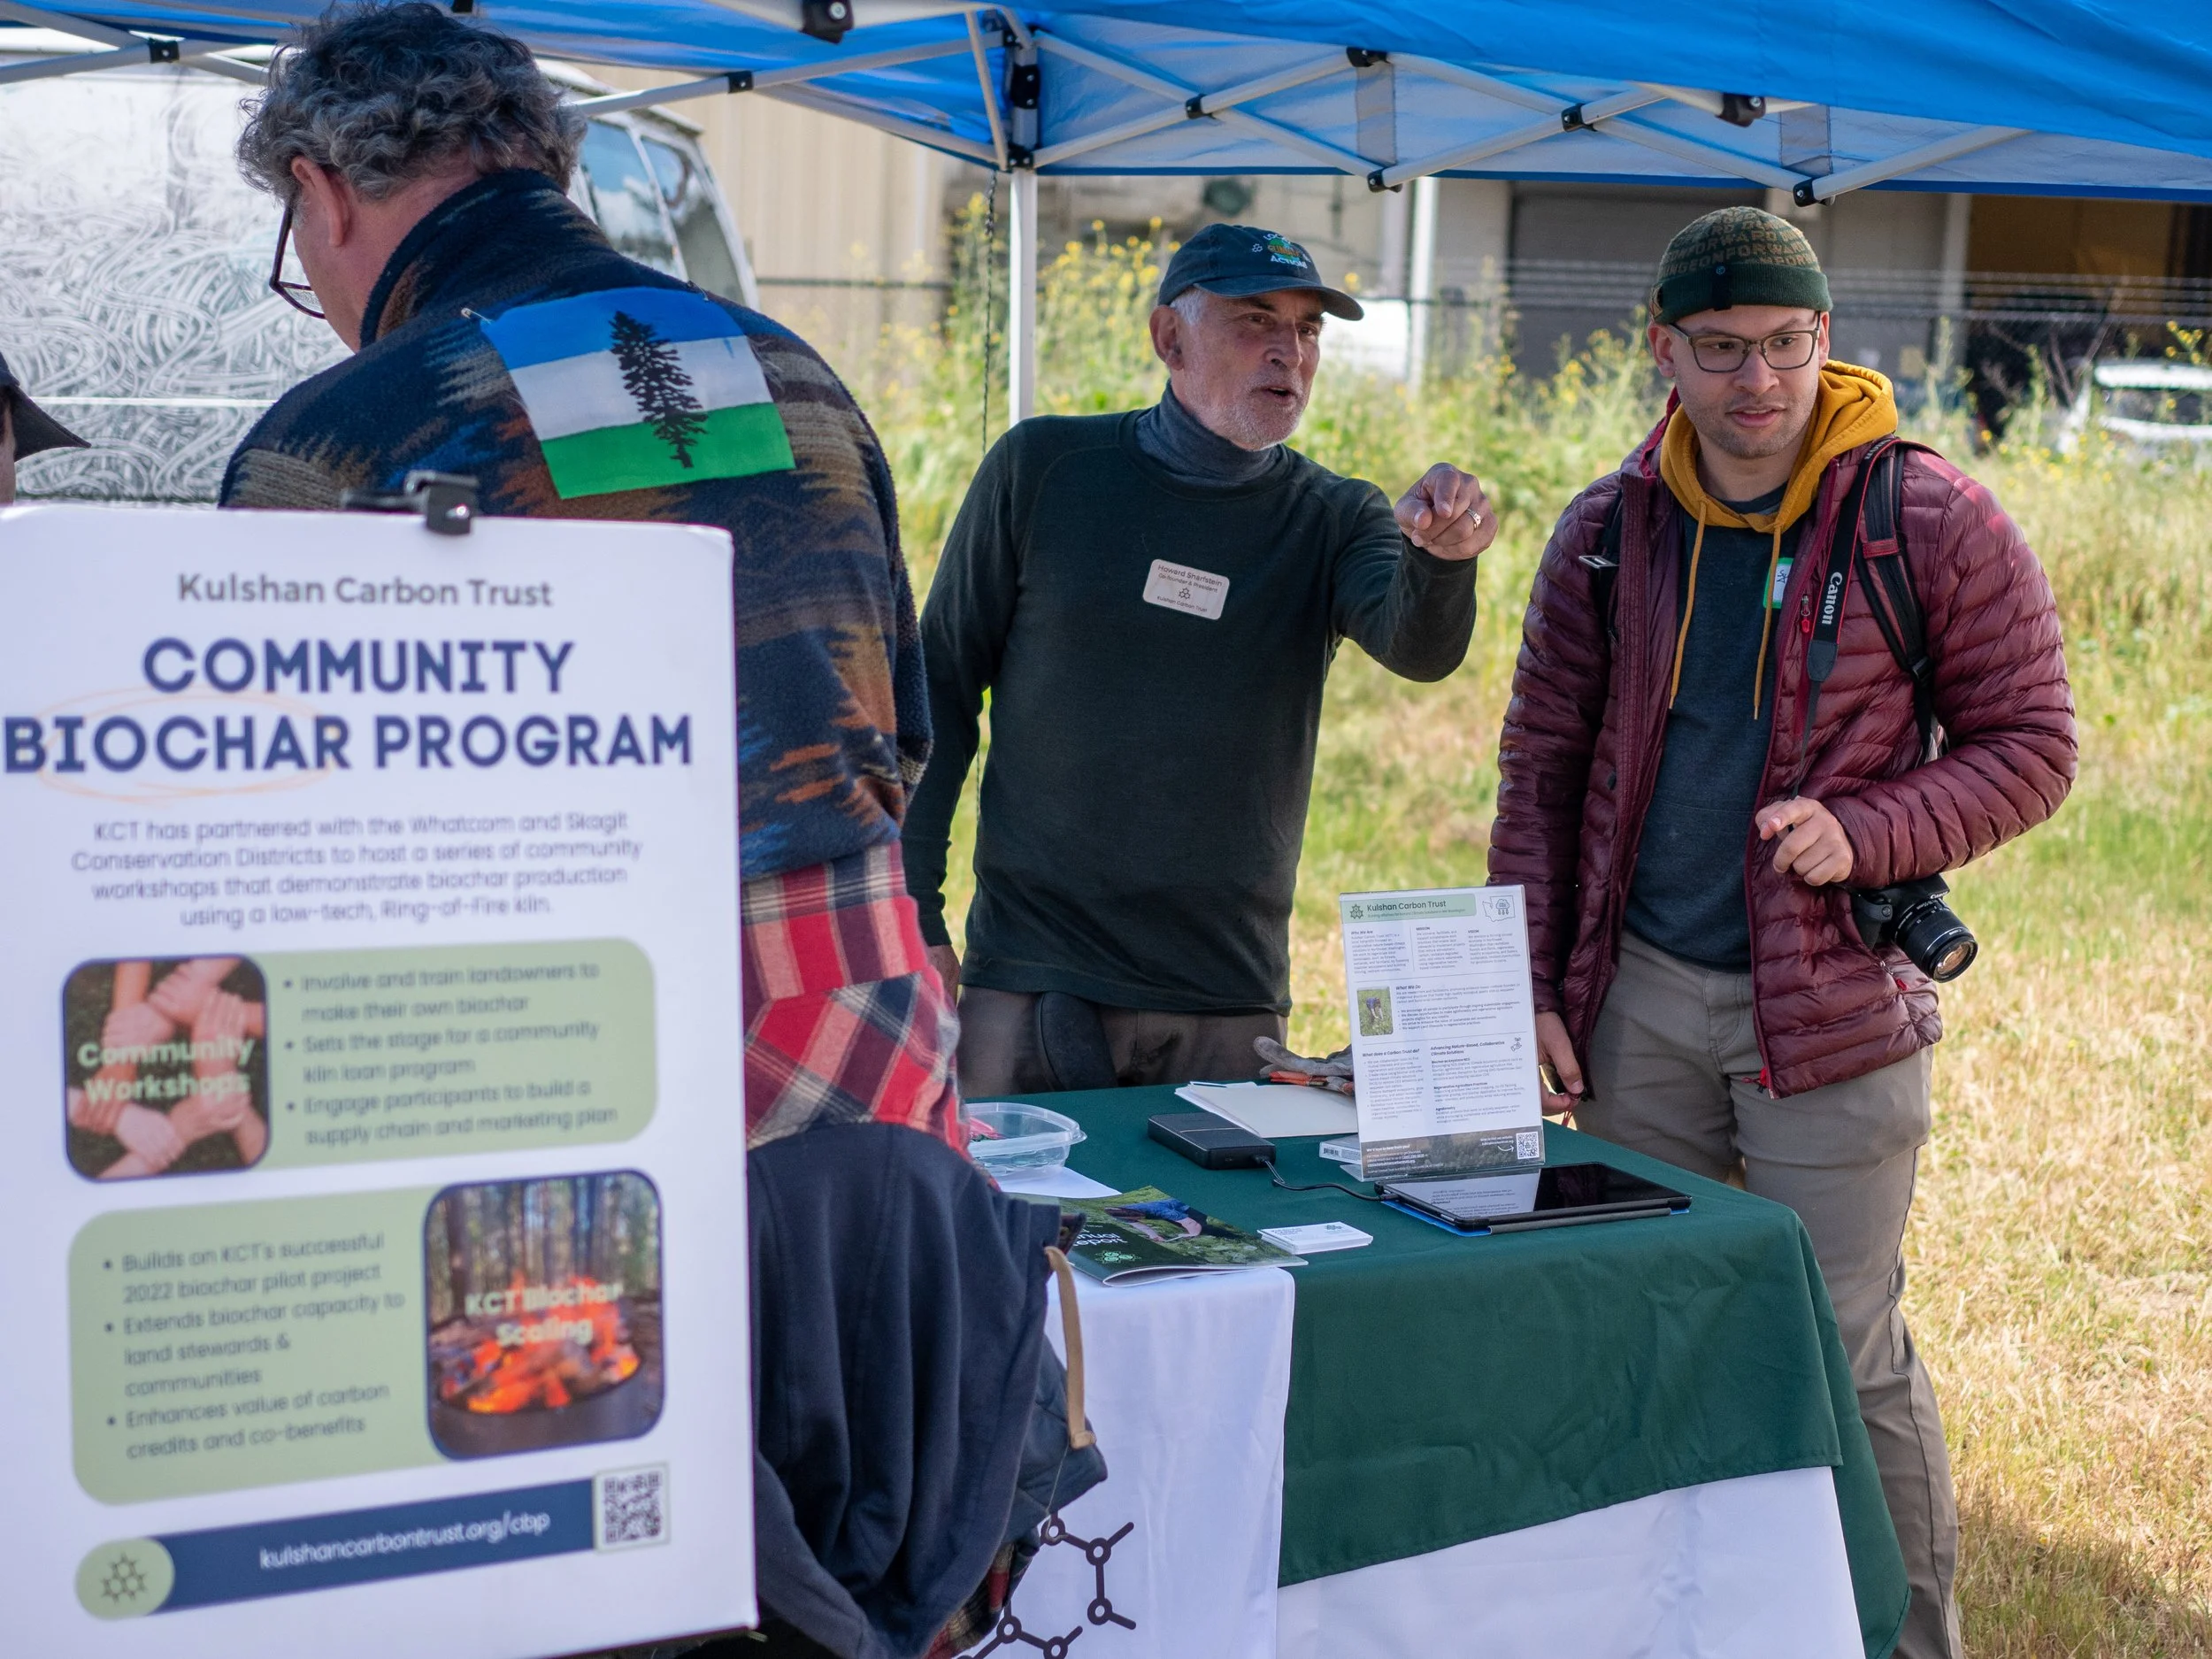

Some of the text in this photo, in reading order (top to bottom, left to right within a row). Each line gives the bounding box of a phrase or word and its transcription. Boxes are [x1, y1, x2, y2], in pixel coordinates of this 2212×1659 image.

[179, 572, 553, 607] Kulshan Carbon Trust
[1157, 565, 1222, 586] Howard Sharfstein
[1822, 572, 1843, 625] Canon
[142, 637, 574, 694] COMMUNITY
[4, 713, 693, 773] BIOCHAR PROGRAM
[94, 812, 628, 845] KCT has partnered with the Whatcom and Skagit
[71, 839, 642, 871] Conservation Districts to host a series of community
[91, 865, 628, 901] workshops that demonstrate biochar production
[180, 908, 244, 930] using
[249, 909, 266, 924] a
[380, 895, 510, 924] Ring-of-Fire
[301, 962, 601, 993] Involve and train landowners to
[302, 995, 530, 1023] make their own biochar
[77, 1035, 256, 1068] Community
[303, 1021, 602, 1055] Sets the stage for a community
[83, 1072, 251, 1102] Workshops
[303, 1058, 476, 1085] kiln loan program
[303, 1080, 593, 1117] Engage participants to build a
[305, 1106, 618, 1148] supply chain and marketing plan
[122, 1250, 186, 1272] Builds
[189, 1249, 217, 1265] on
[279, 1232, 385, 1258] successful
[1072, 1238, 1128, 1247] eport
[123, 1263, 382, 1304] 2022 biochar pilot project
[465, 1283, 624, 1316] KCT Biochar
[123, 1291, 406, 1335] Extends biochar capacity to
[495, 1315, 594, 1348] Scaling
[124, 1332, 292, 1366] land stewards &
[124, 1368, 263, 1398] communities
[126, 1383, 391, 1429] Enhances value of carbon
[126, 1415, 367, 1460] credits and co-benefits
[259, 1509, 550, 1569] kulshancarbontrust.org/cbp
